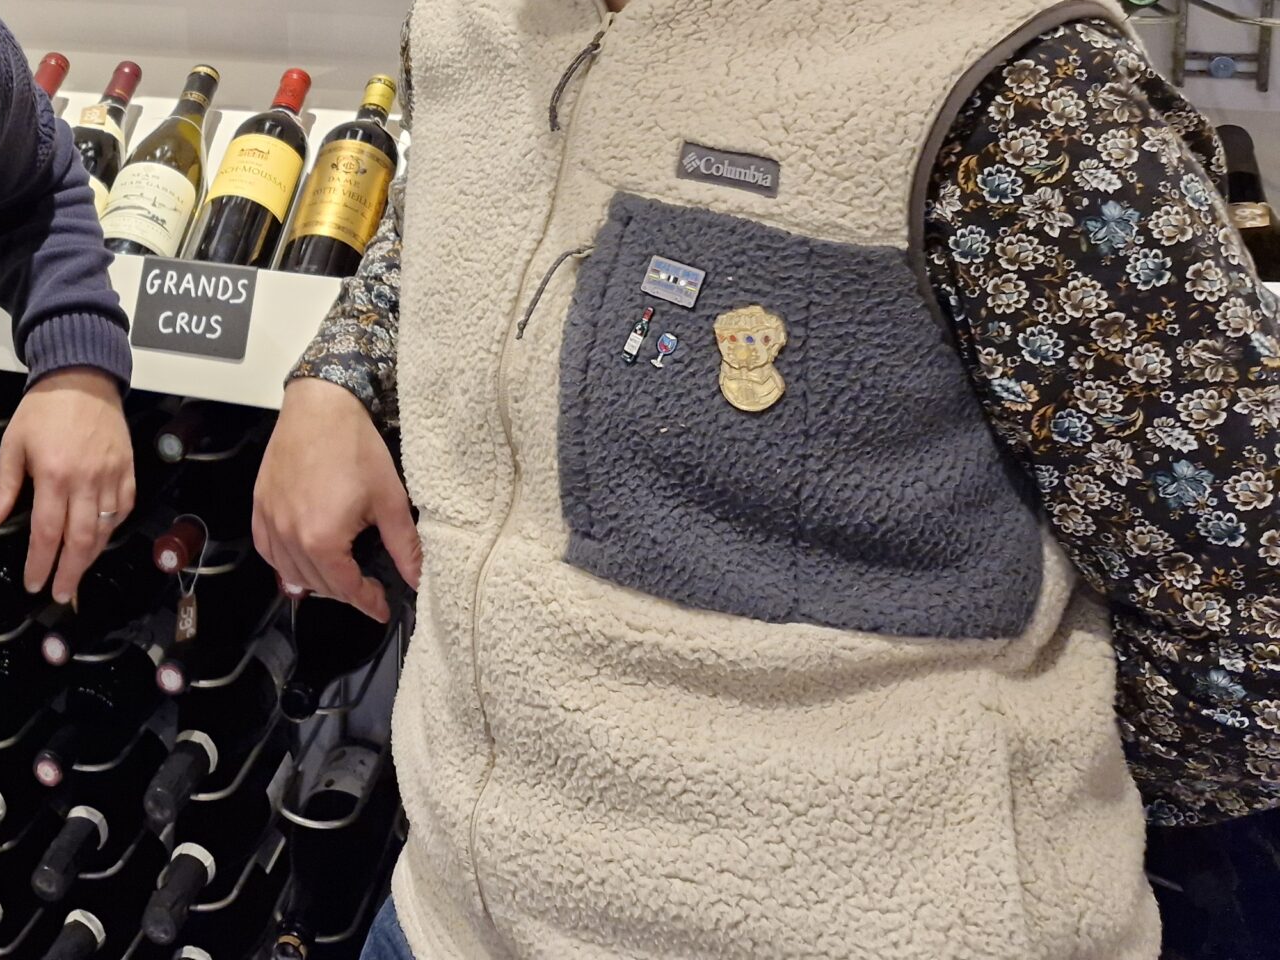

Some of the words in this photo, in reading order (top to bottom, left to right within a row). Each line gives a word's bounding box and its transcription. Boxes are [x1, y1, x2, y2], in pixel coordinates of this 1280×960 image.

[699, 156, 773, 188] Columbia
[145, 268, 250, 305] GRANDS
[157, 310, 224, 340] CRUS
